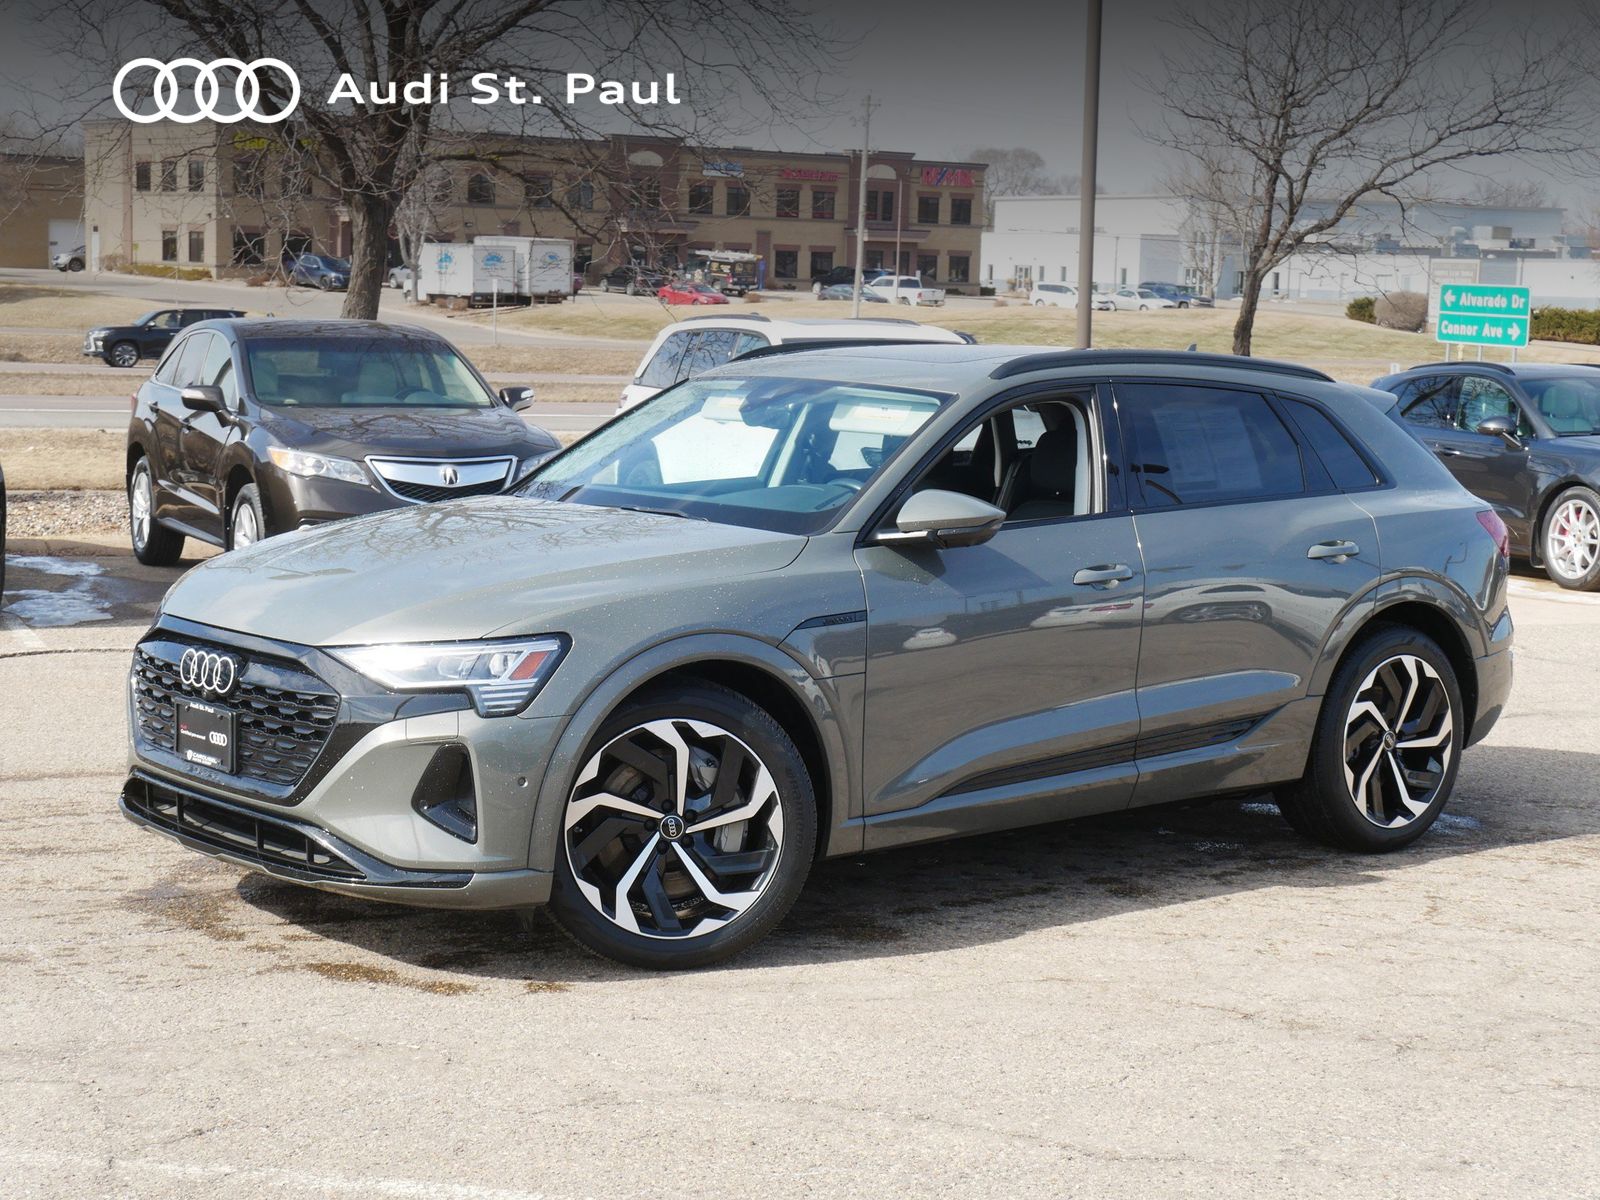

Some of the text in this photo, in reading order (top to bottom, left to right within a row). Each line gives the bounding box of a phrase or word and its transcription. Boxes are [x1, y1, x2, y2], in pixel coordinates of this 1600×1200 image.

[1459, 292, 1526, 309] Alvarado Dr
[1440, 320, 1503, 338] Connor Ave
